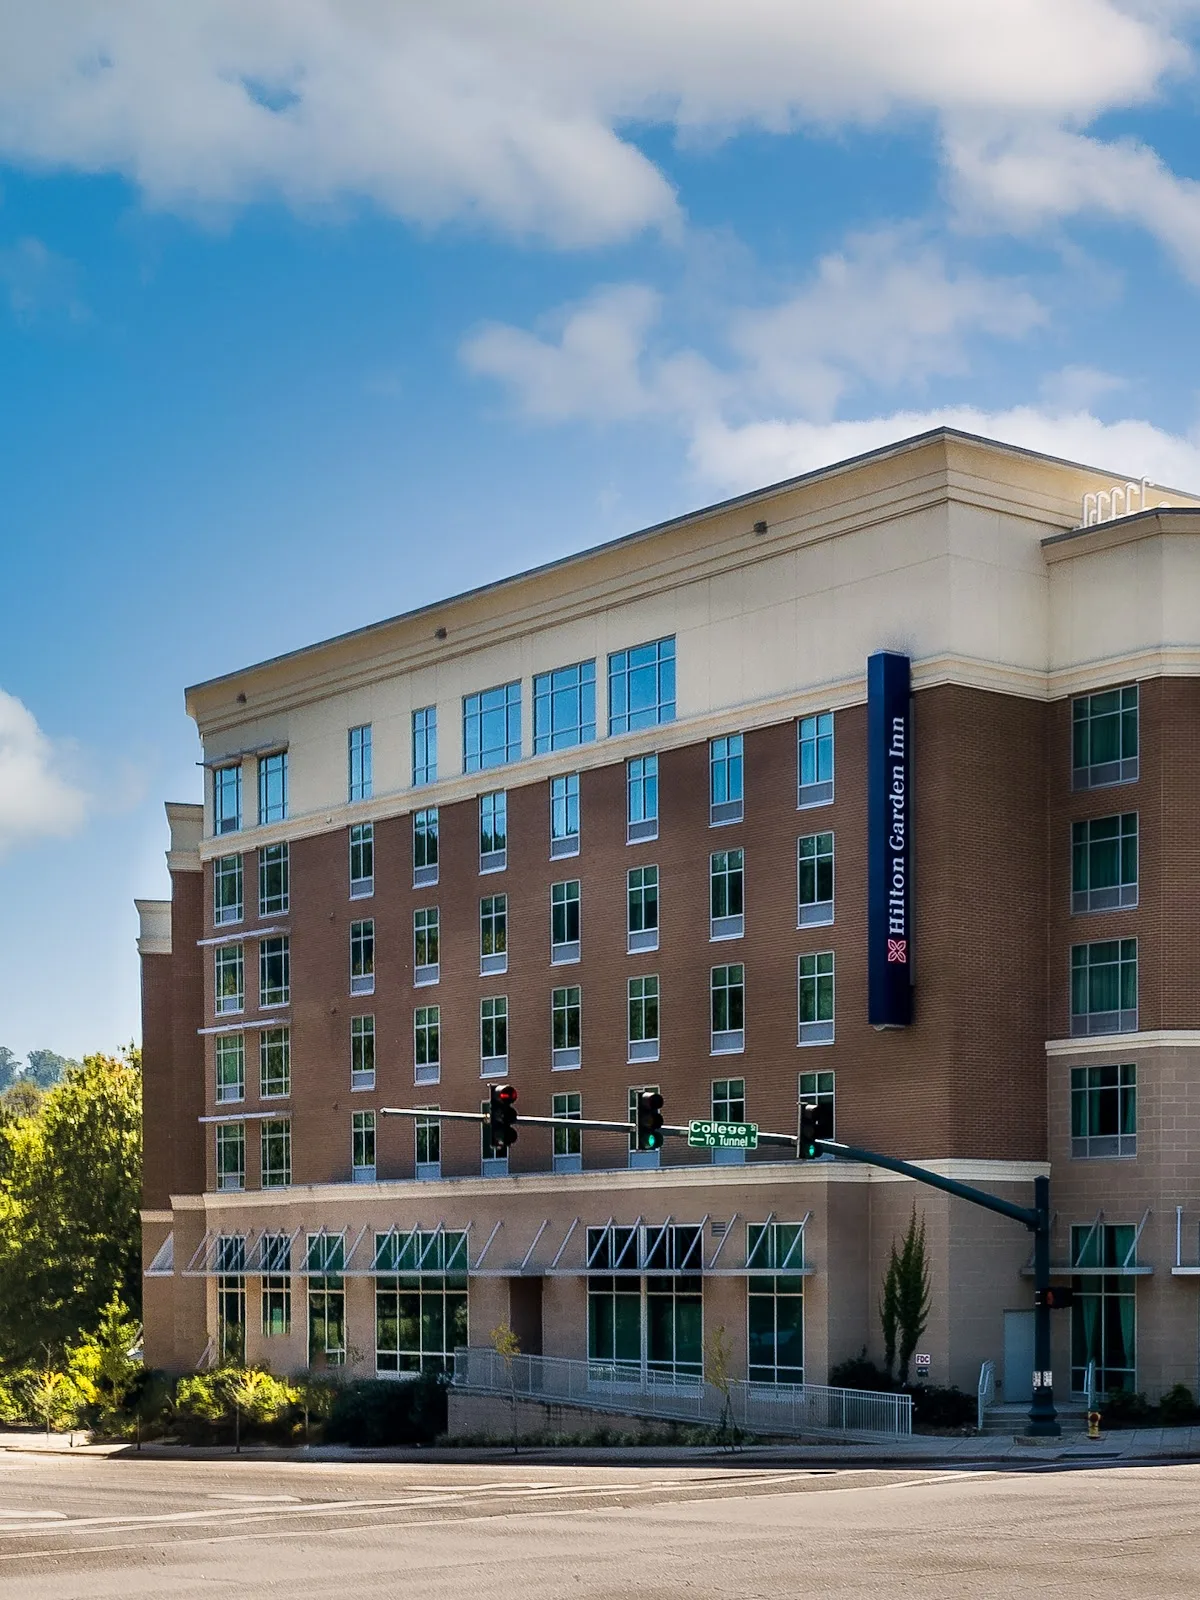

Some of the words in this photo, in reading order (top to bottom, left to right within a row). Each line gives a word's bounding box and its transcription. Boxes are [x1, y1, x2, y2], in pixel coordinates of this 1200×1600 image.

[888, 717, 905, 759] Inn
[888, 765, 905, 851] Garden
[888, 856, 905, 936] Hilton
[690, 1121, 747, 1135] College
[704, 1133, 715, 1146] To
[719, 1134, 748, 1147] Tunnel
[916, 1355, 929, 1363] FDC
